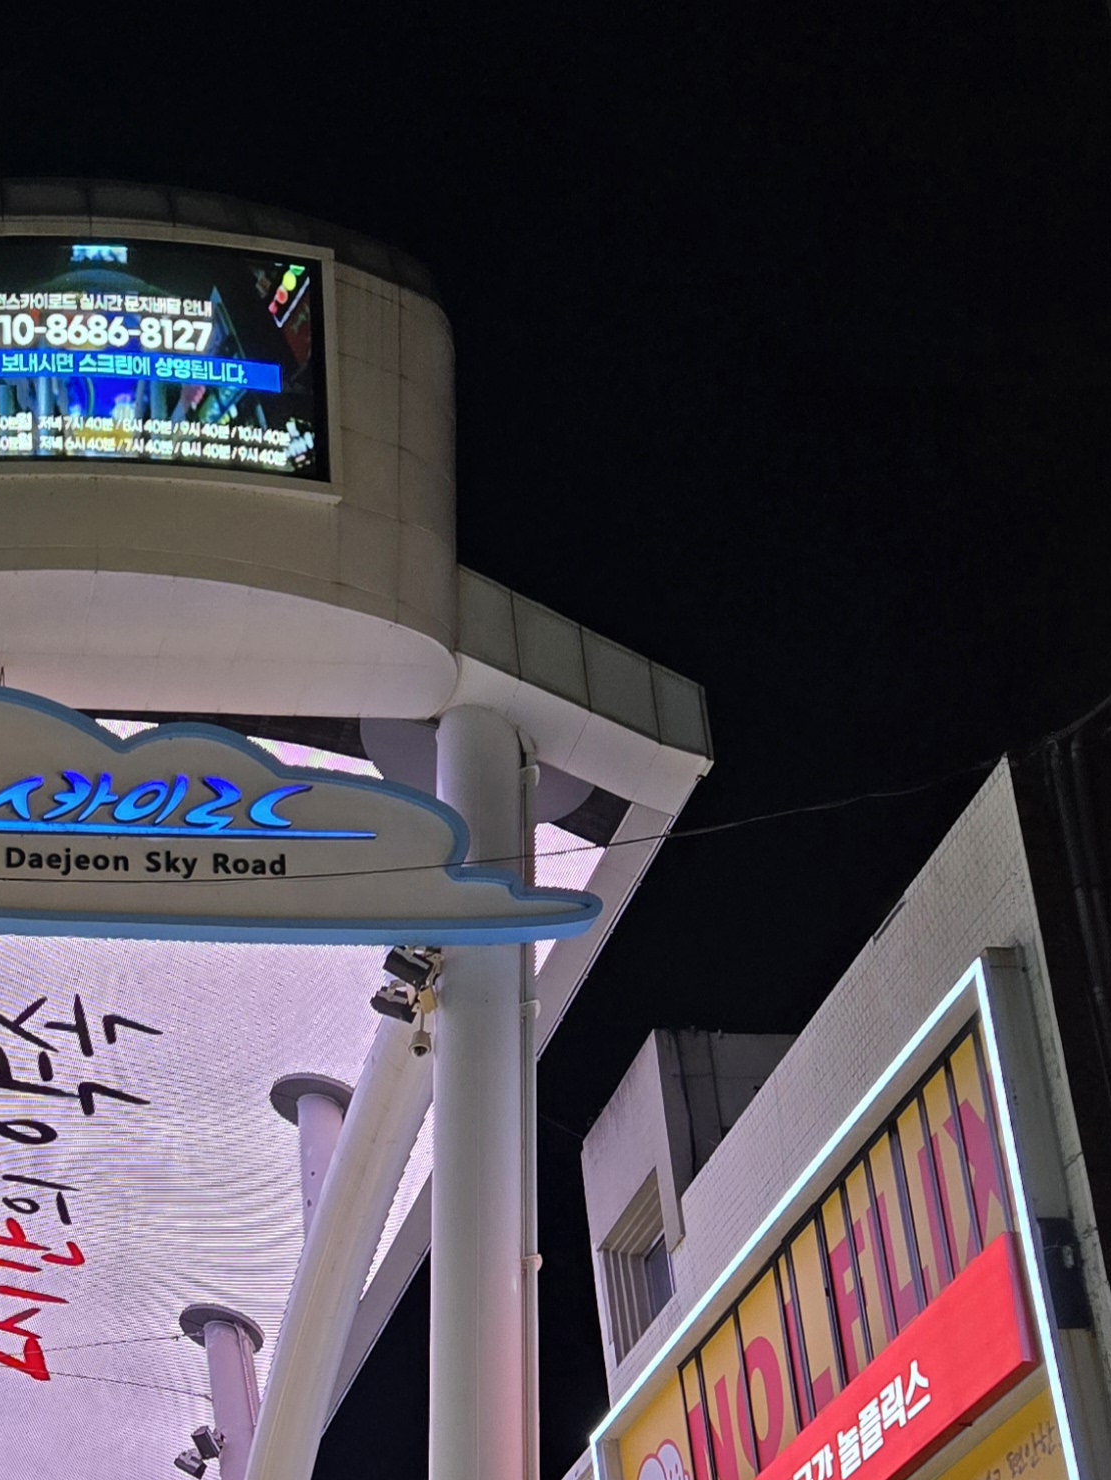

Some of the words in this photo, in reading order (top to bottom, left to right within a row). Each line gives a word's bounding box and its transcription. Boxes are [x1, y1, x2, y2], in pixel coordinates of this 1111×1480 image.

[183, 299, 213, 318] 안내
[1, 353, 74, 375] 보내시면
[78, 354, 151, 376] 스크린에
[5, 846, 129, 876] Daejeon
[145, 850, 197, 879] Sky
[212, 852, 287, 877] Road
[837, 1360, 932, 1480] 놀플릭스
